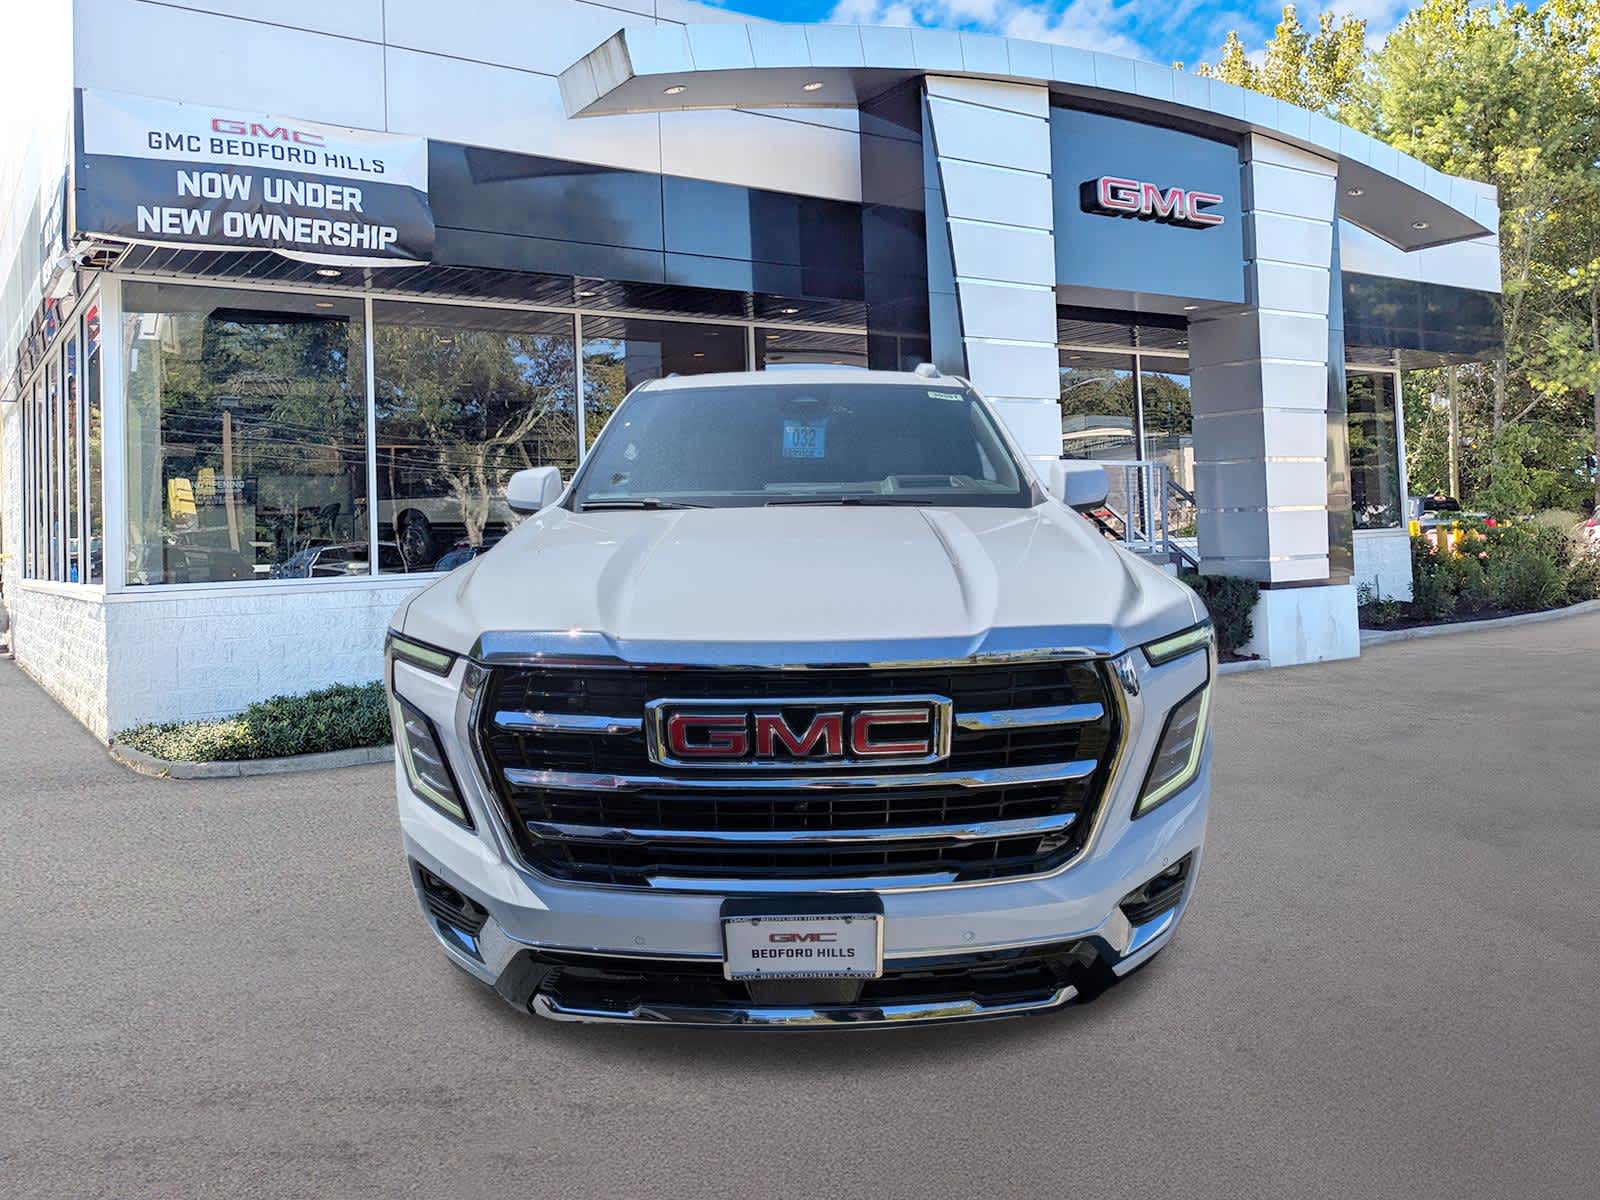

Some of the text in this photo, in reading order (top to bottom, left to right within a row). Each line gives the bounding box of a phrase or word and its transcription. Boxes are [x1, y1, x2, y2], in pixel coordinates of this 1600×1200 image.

[148, 131, 385, 174] GMC BEDFORD HILLS
[211, 118, 326, 148] GMC
[177, 170, 364, 213] NOW UNDER
[1097, 175, 1225, 224] GMC
[136, 205, 398, 250] NEW OWNERSHIP
[792, 428, 817, 447] 032
[667, 708, 930, 757] GMC
[751, 948, 855, 958] BEDFORD HILLS
[769, 932, 837, 943] GMC
